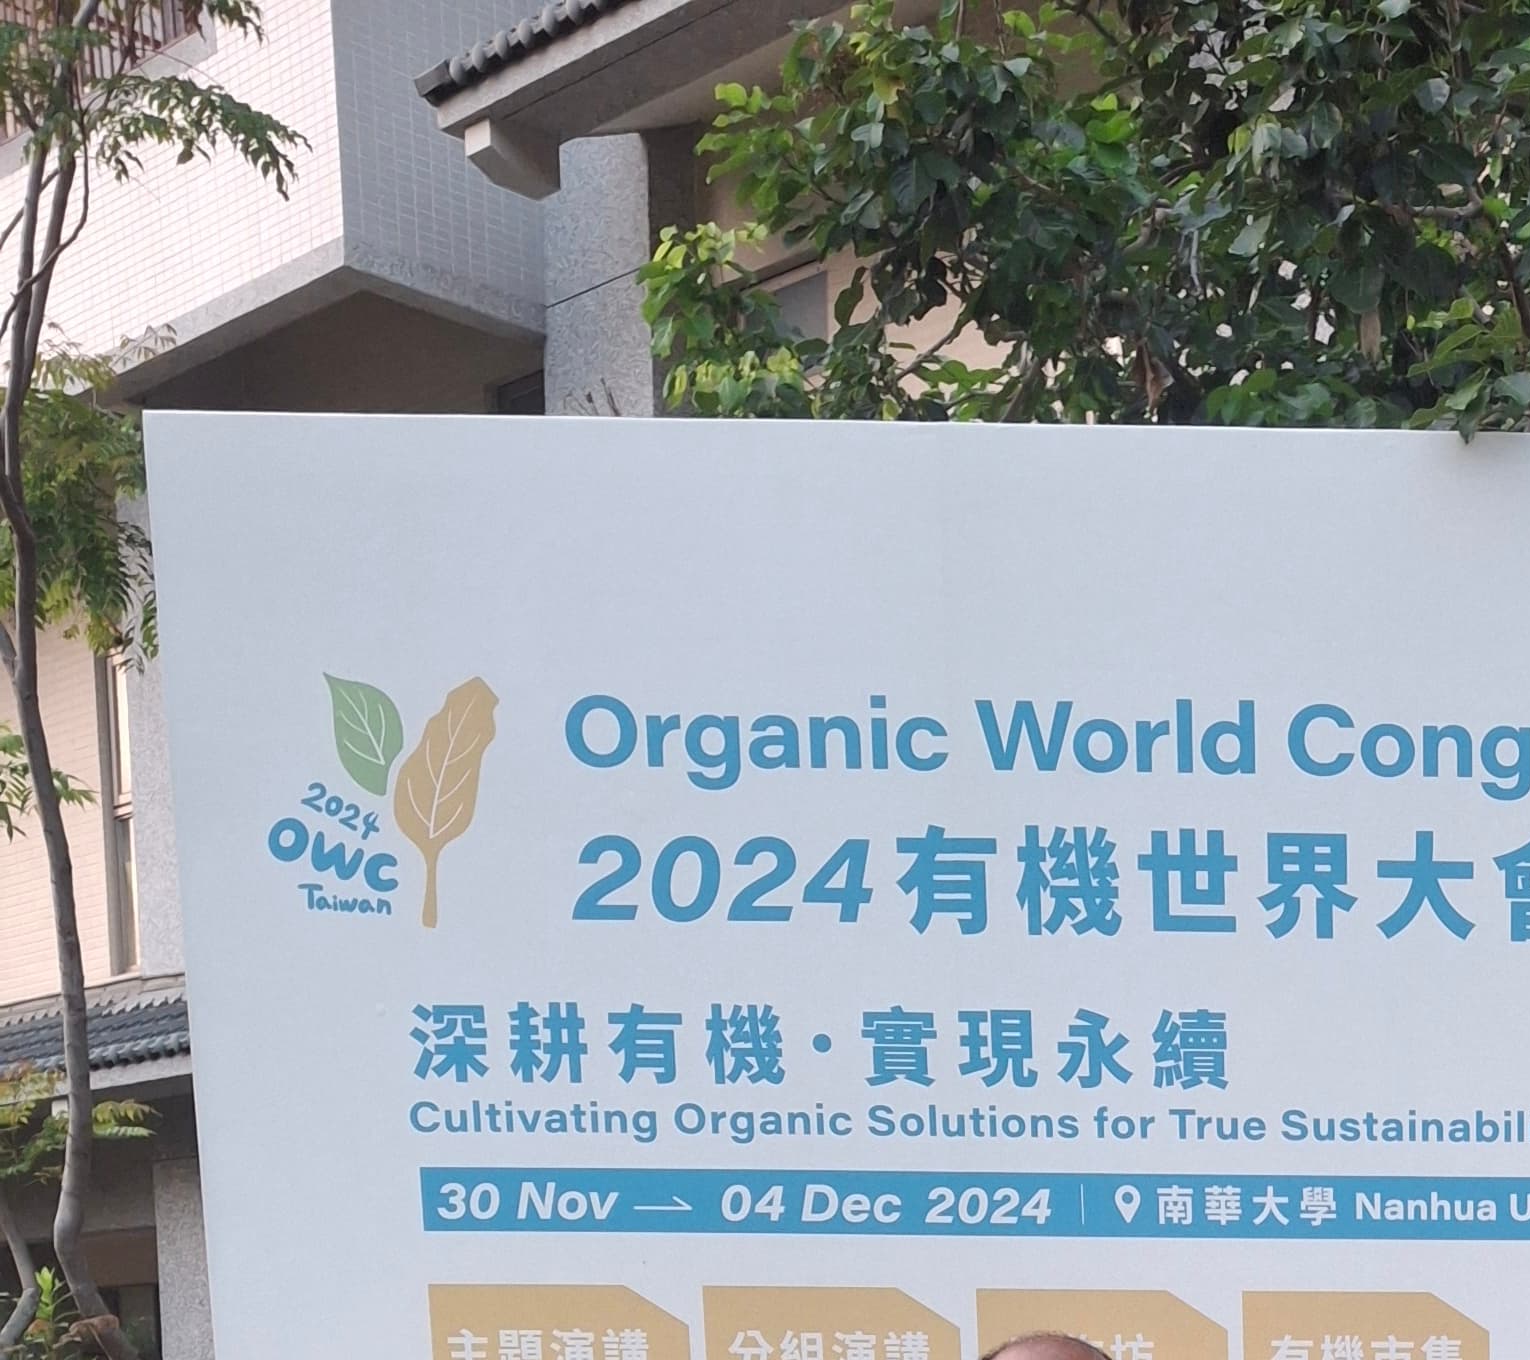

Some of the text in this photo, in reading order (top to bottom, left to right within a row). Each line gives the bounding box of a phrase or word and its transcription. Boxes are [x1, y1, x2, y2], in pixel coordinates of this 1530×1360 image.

[565, 695, 948, 790] Organic
[975, 699, 1255, 775] World
[300, 782, 381, 841] 2024
[268, 818, 399, 892] OWC
[298, 884, 392, 915] Taiwan
[410, 1100, 657, 1143] Cultivating
[675, 1103, 852, 1143] Organic
[869, 1105, 1079, 1138] Solutions
[1094, 1106, 1155, 1139] for
[1169, 1109, 1266, 1140] True
[438, 1183, 499, 1219] 30
[518, 1182, 619, 1220] Nov
[722, 1185, 784, 1221] 04
[802, 1184, 901, 1223] Dec
[925, 1187, 1051, 1224] 2024
[1157, 1185, 1336, 1226] 南華大學
[1356, 1192, 1496, 1221] Nanhua
